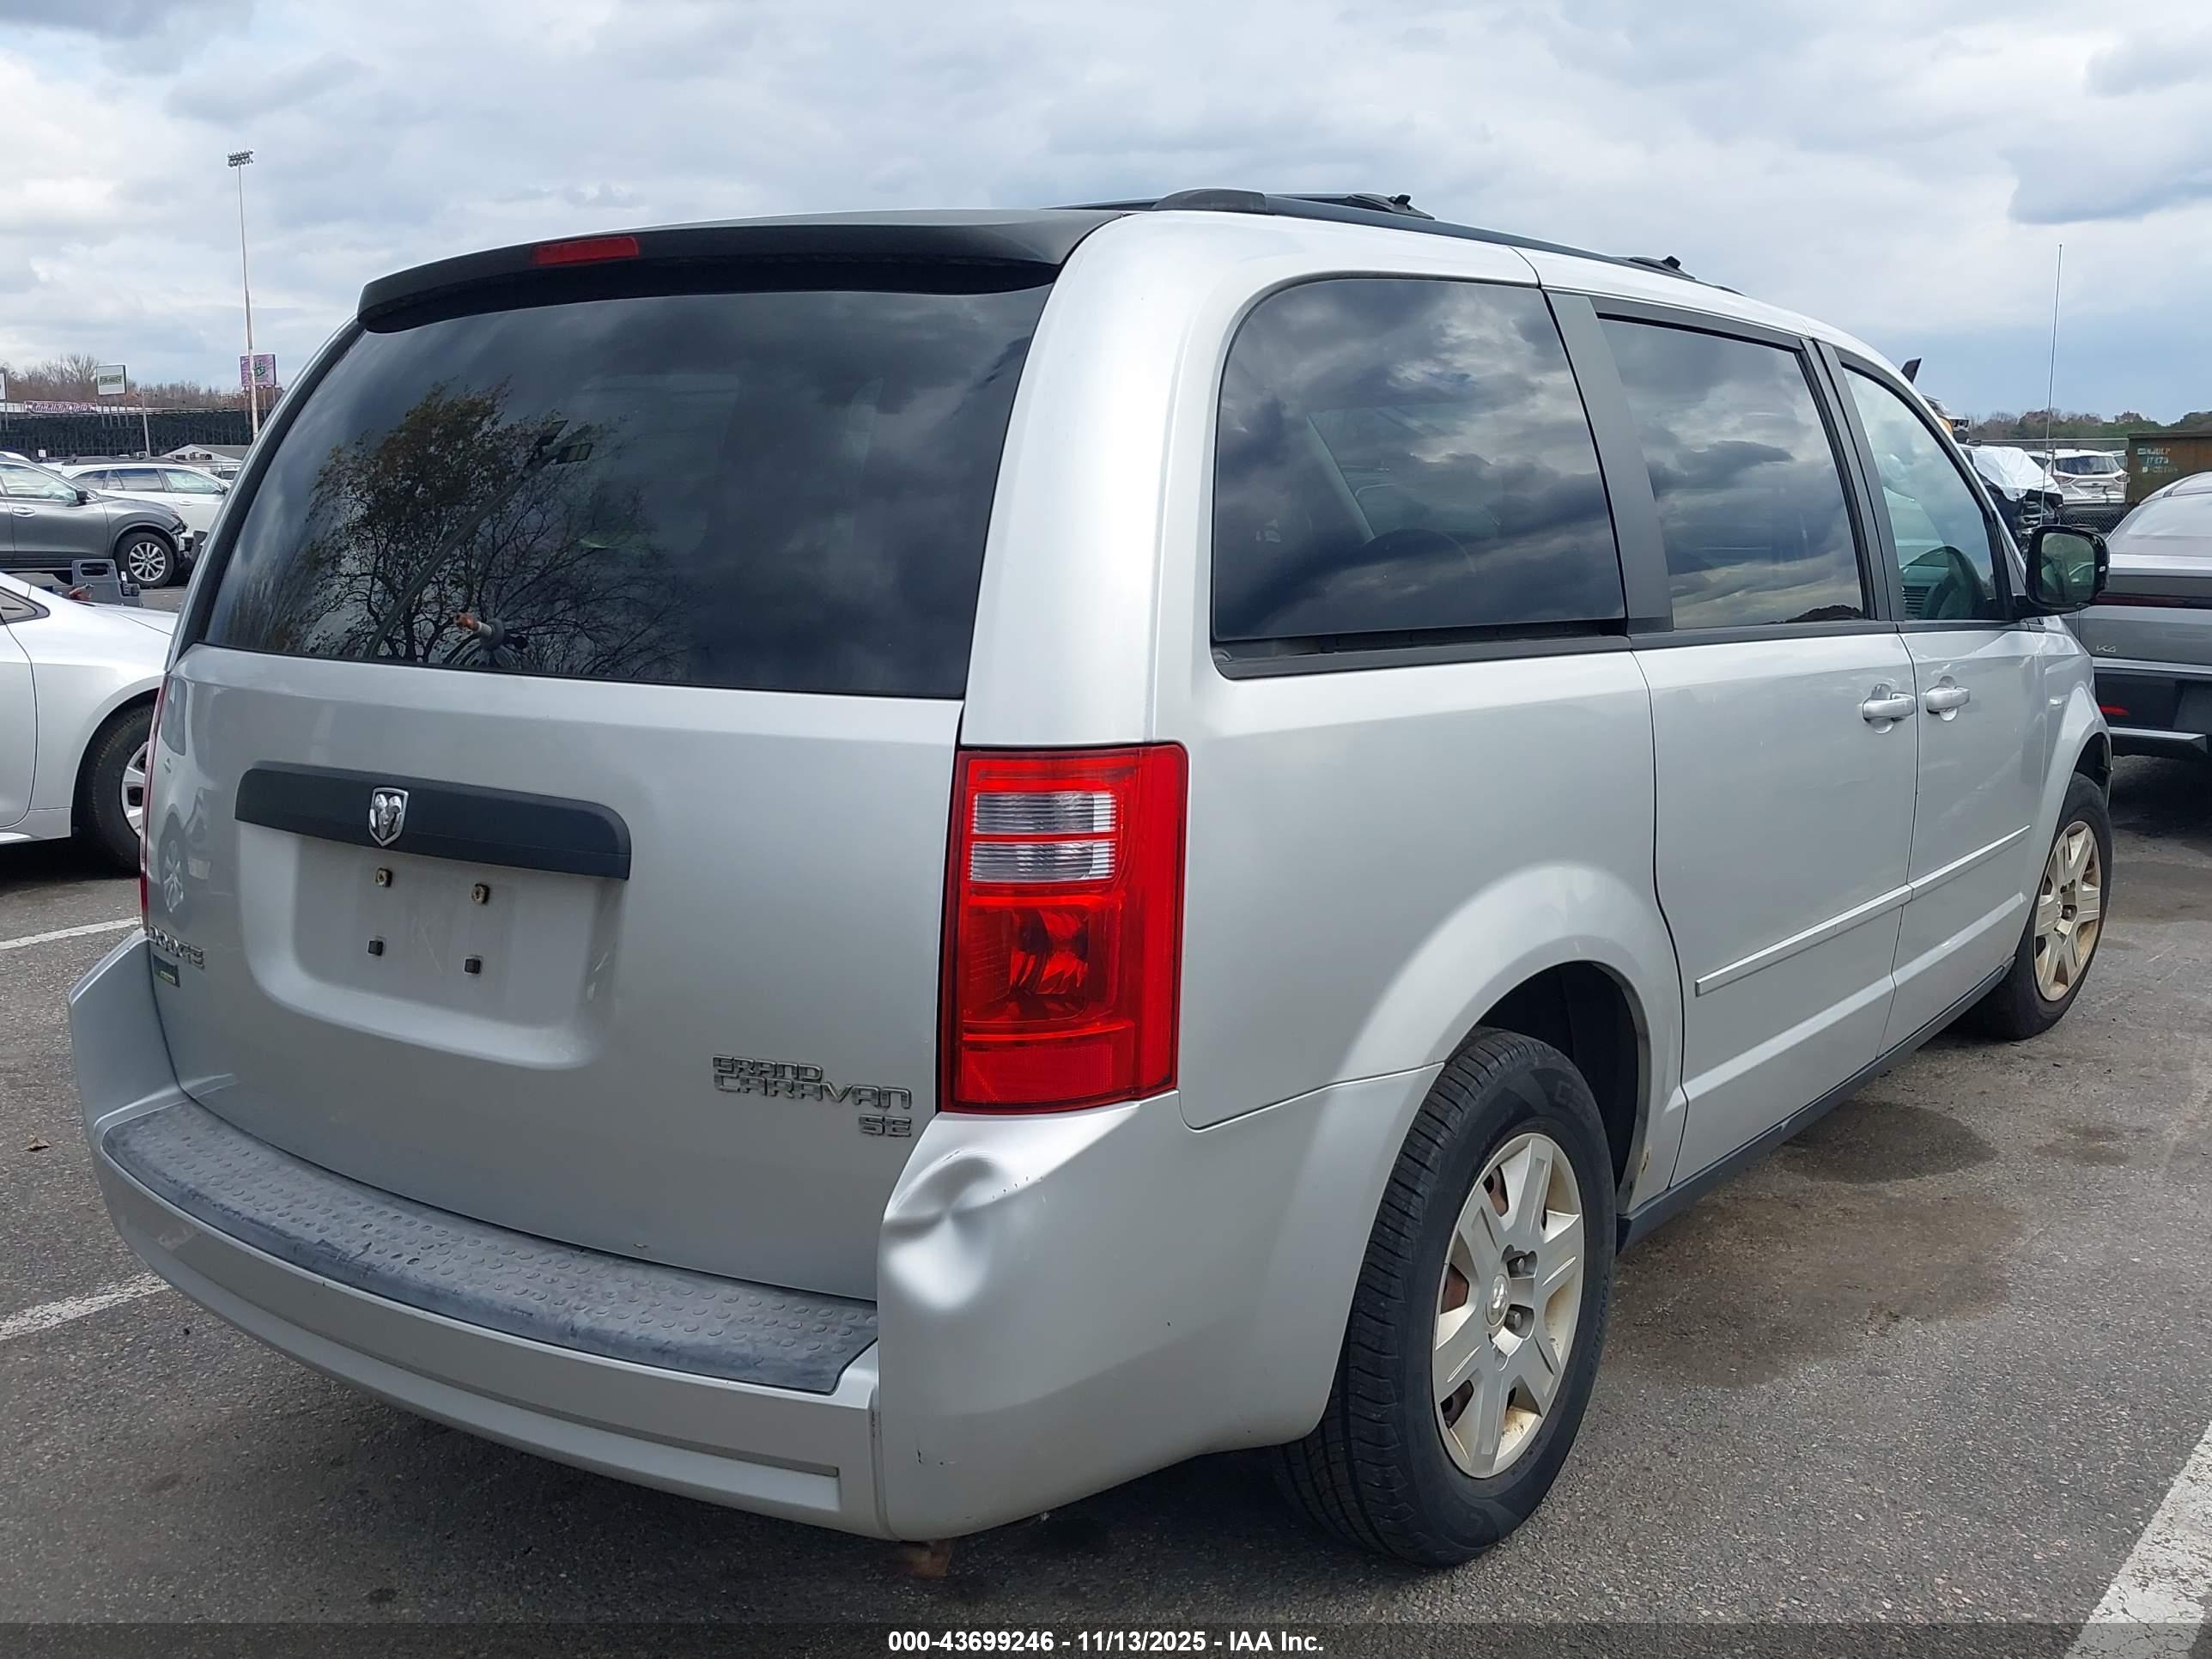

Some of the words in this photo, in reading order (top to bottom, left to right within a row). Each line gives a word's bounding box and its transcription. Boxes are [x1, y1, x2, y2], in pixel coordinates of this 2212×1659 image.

[713, 1054, 823, 1082] GRAND
[714, 1073, 912, 1110] CARAVAN
[859, 1115, 912, 1138] SE
